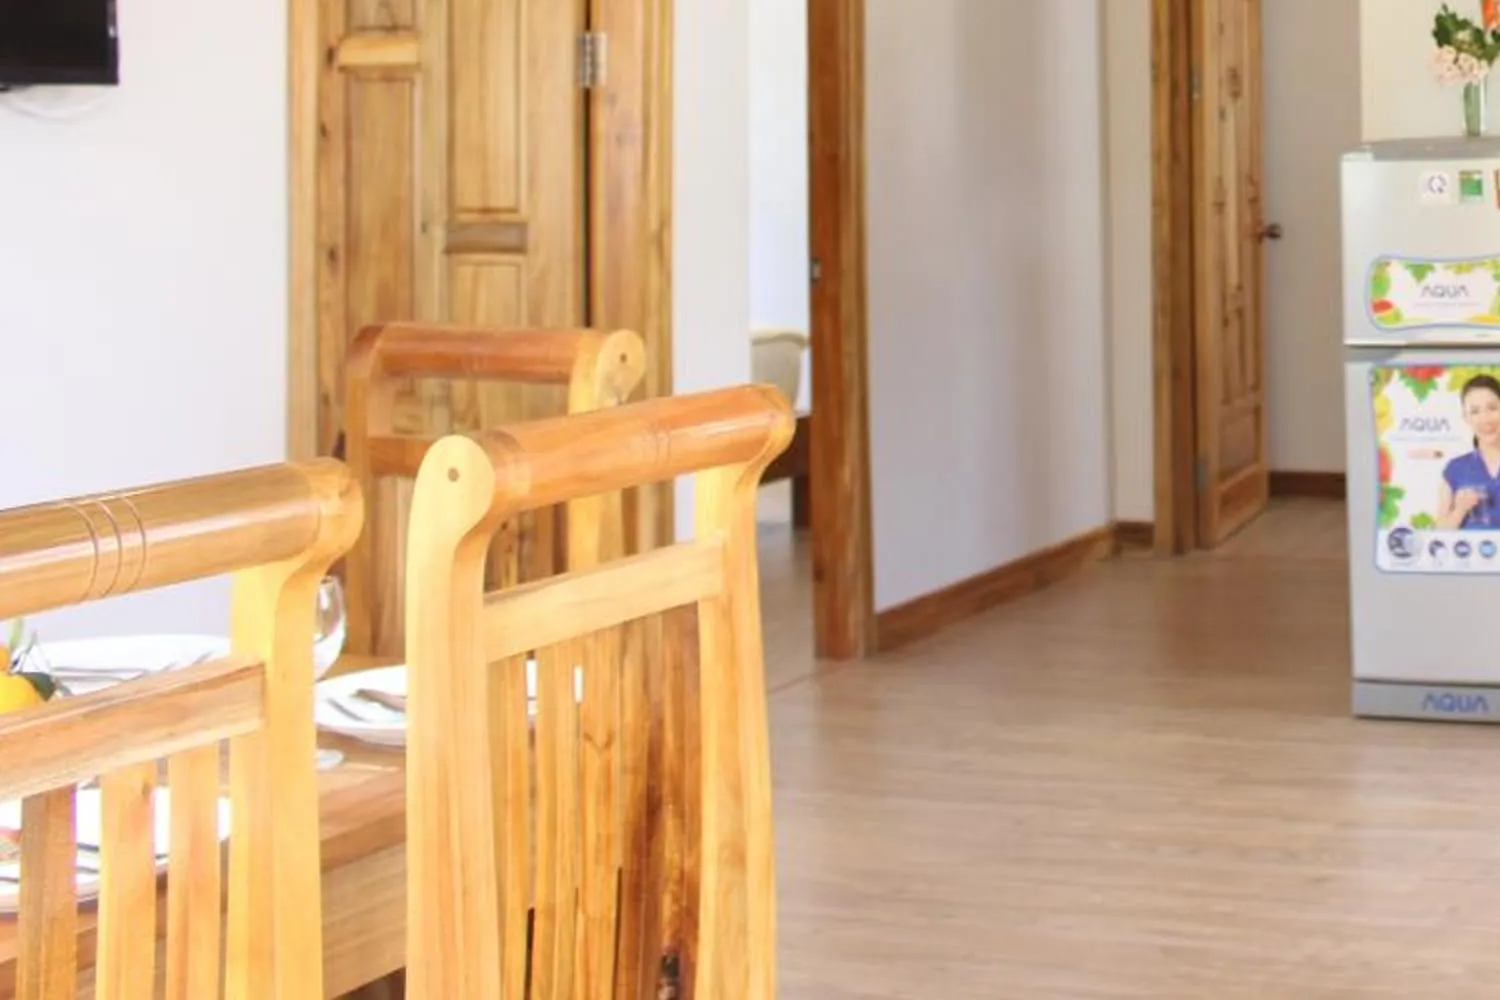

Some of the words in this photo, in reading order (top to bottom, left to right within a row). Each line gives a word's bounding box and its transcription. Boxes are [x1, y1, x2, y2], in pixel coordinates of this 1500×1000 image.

[1421, 284, 1469, 299] AQUA
[1399, 417, 1451, 432] AQUA
[1421, 692, 1489, 713] AQUA
